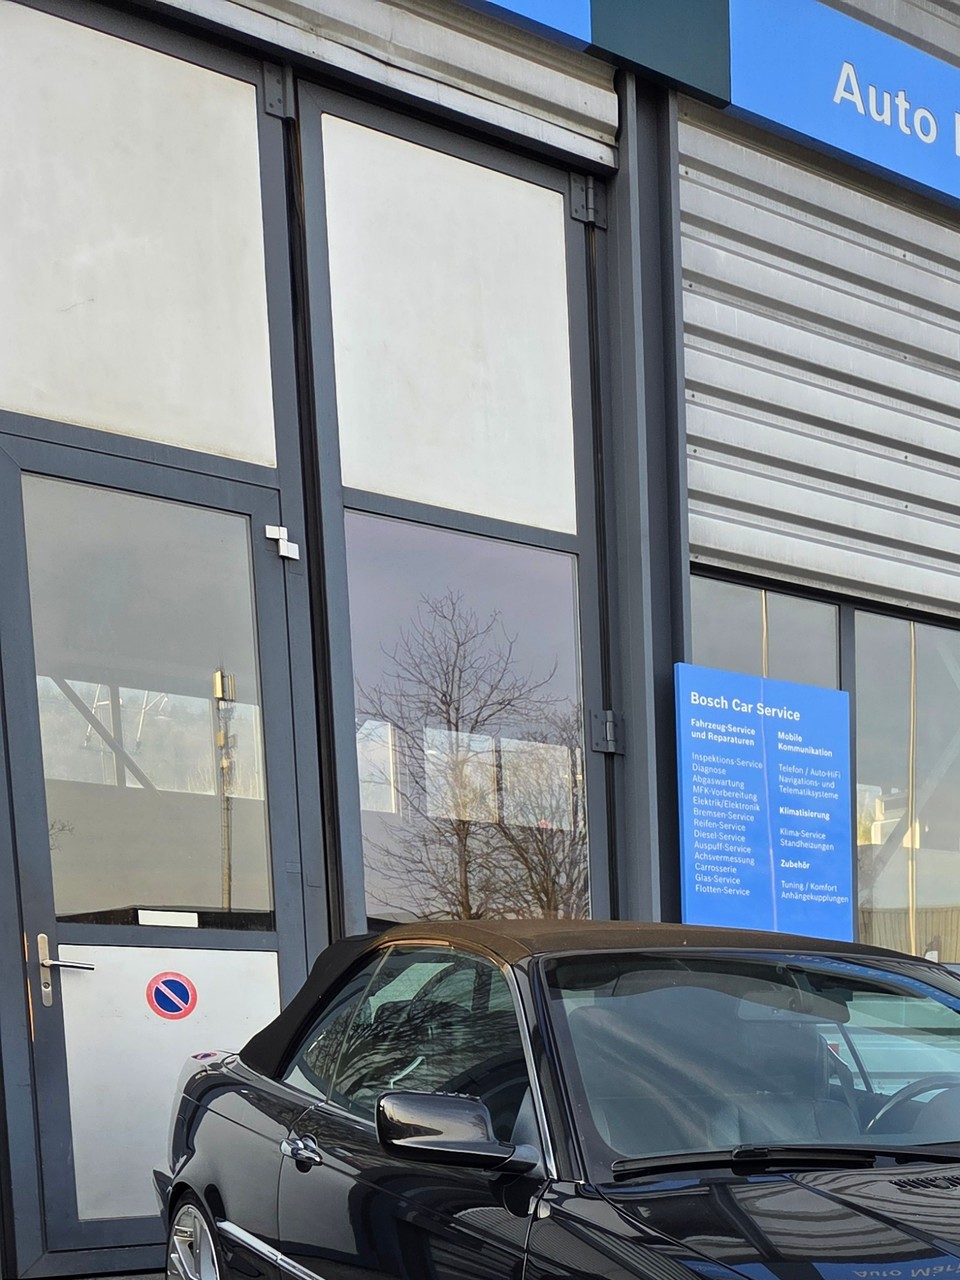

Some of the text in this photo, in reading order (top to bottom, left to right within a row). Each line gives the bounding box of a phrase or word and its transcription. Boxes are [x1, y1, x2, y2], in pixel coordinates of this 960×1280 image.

[833, 61, 938, 144] Auto
[691, 691, 800, 721] Bosch Car Service
[691, 718, 756, 736] Fahrzeug-Service
[691, 731, 755, 746] und Reparaturen
[778, 731, 802, 742] Mobile
[778, 742, 833, 757] Kommunikation
[692, 752, 763, 769] Inspektions-Service
[692, 762, 727, 775] Diagnose
[778, 763, 803, 774] Telefon
[692, 774, 745, 790] Abgaswartung
[779, 774, 835, 789] Navigations- und
[693, 785, 758, 802] MFK-Vorbereitung
[779, 785, 839, 800] Telematiksysteme
[693, 796, 760, 812] Elektrik/Elektronik
[693, 807, 755, 822] Bremsen-Service
[779, 806, 830, 821] Klimatisierung
[693, 818, 746, 832] Reifen-Service
[694, 829, 746, 842] Diesel-Service
[780, 828, 827, 840] Klima-Service
[694, 840, 752, 854] Auspuff-Service
[780, 838, 834, 852] Standheizungen
[694, 852, 756, 866] Achsvermessung
[780, 859, 810, 869] Zubehör
[694, 862, 737, 873] Carrosserie
[695, 873, 740, 885] Glas-Service
[695, 884, 750, 896] Flotten-Service
[781, 880, 804, 891] Tuning
[810, 882, 837, 893] Komfort
[781, 891, 849, 904] Anhängekupplungen
